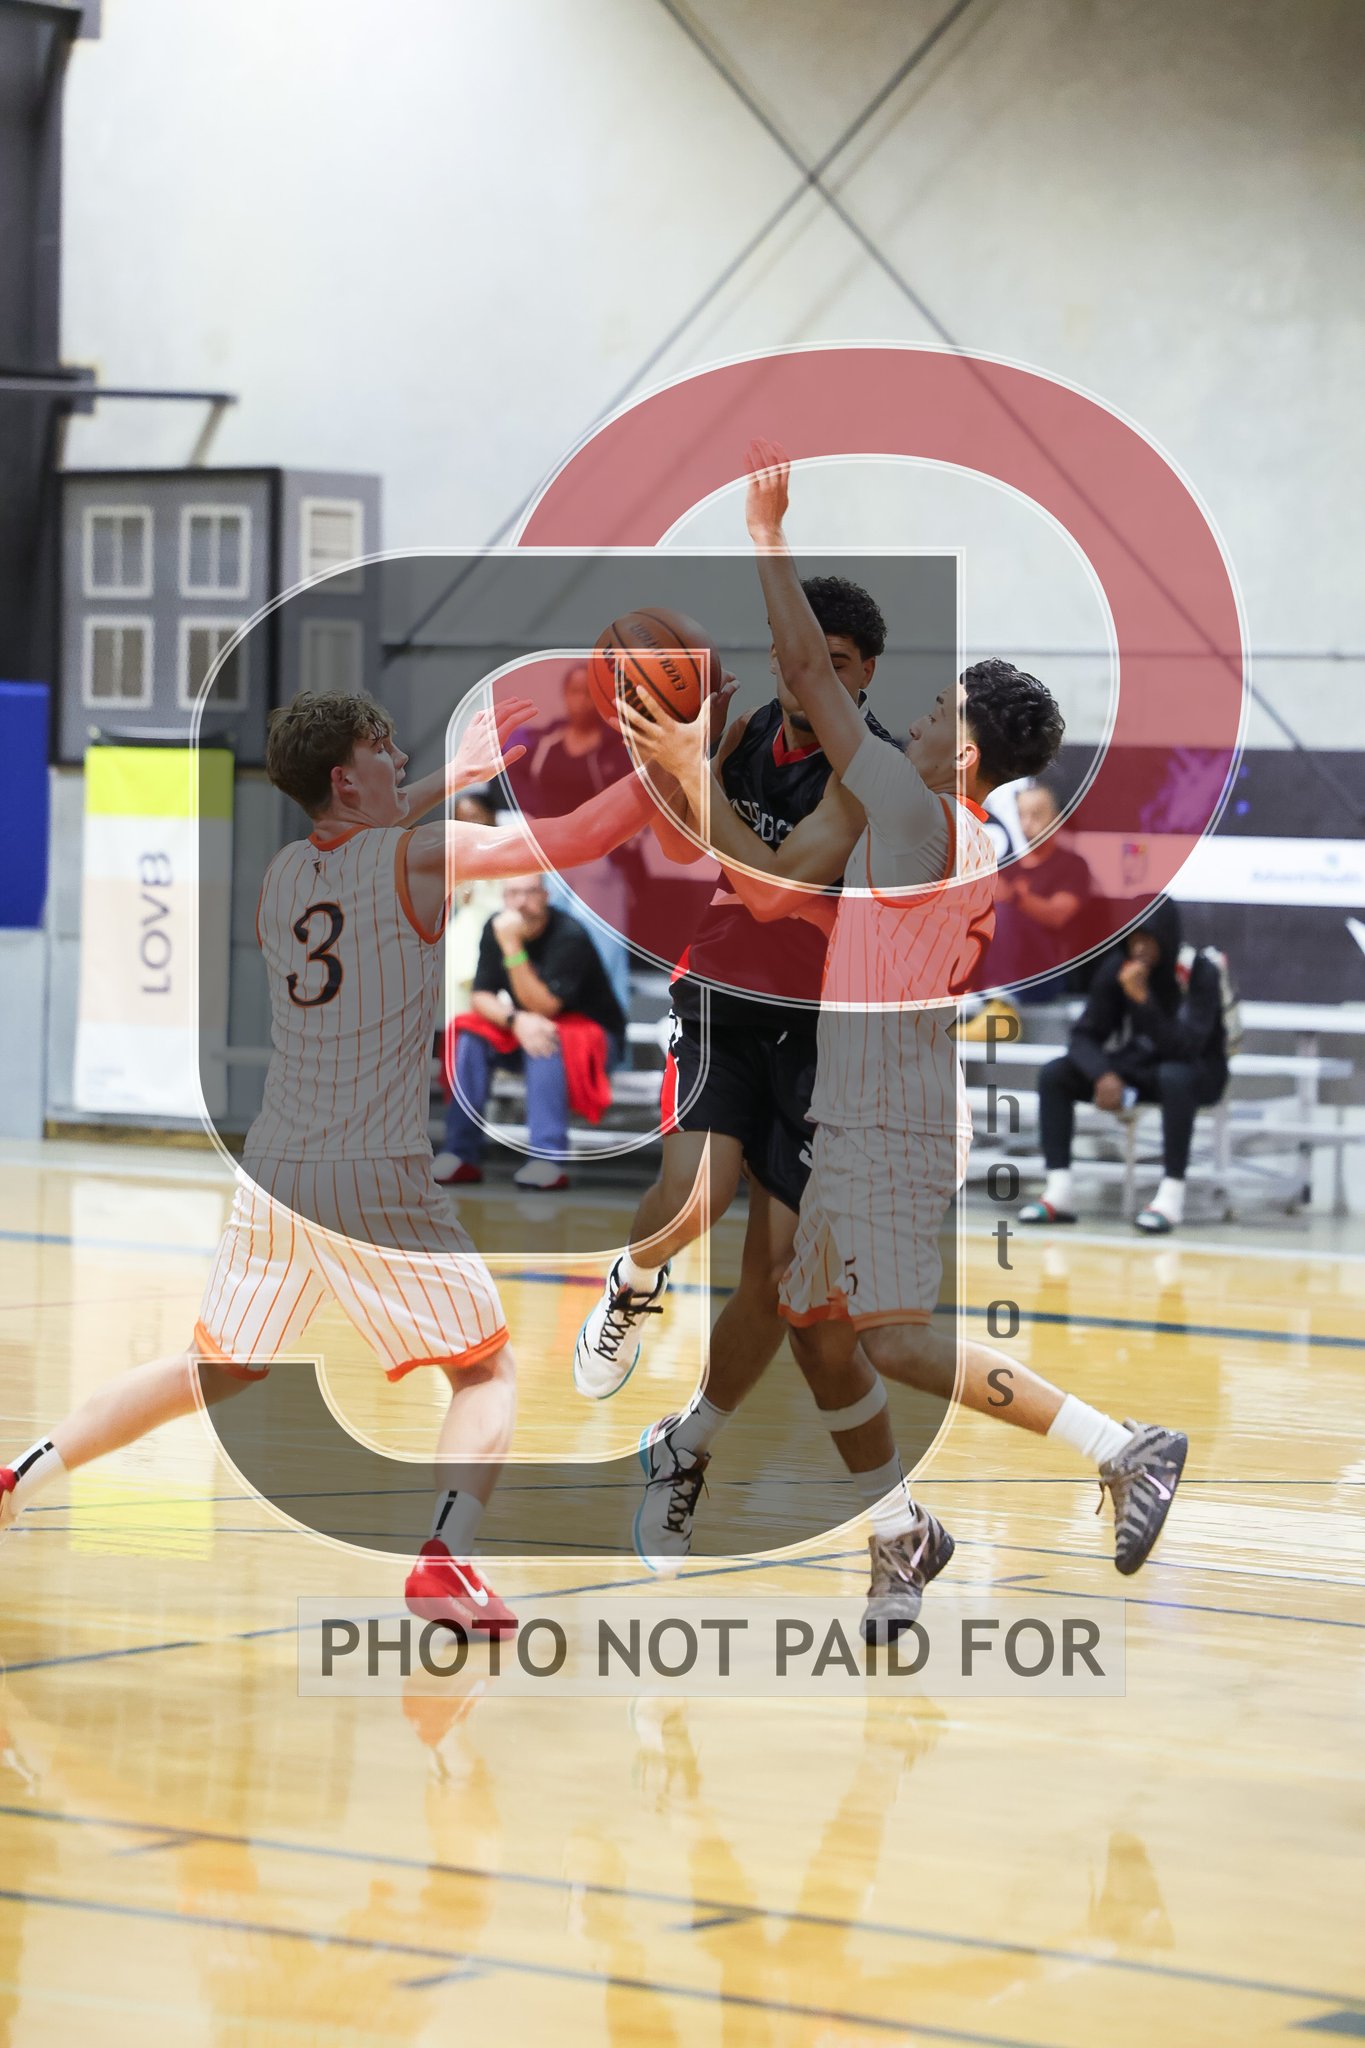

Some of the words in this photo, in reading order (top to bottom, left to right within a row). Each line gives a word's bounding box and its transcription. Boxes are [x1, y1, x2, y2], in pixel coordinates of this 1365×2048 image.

[139, 852, 172, 994] LOVB
[286, 902, 344, 1008] 3
[844, 1256, 859, 1296] 5
